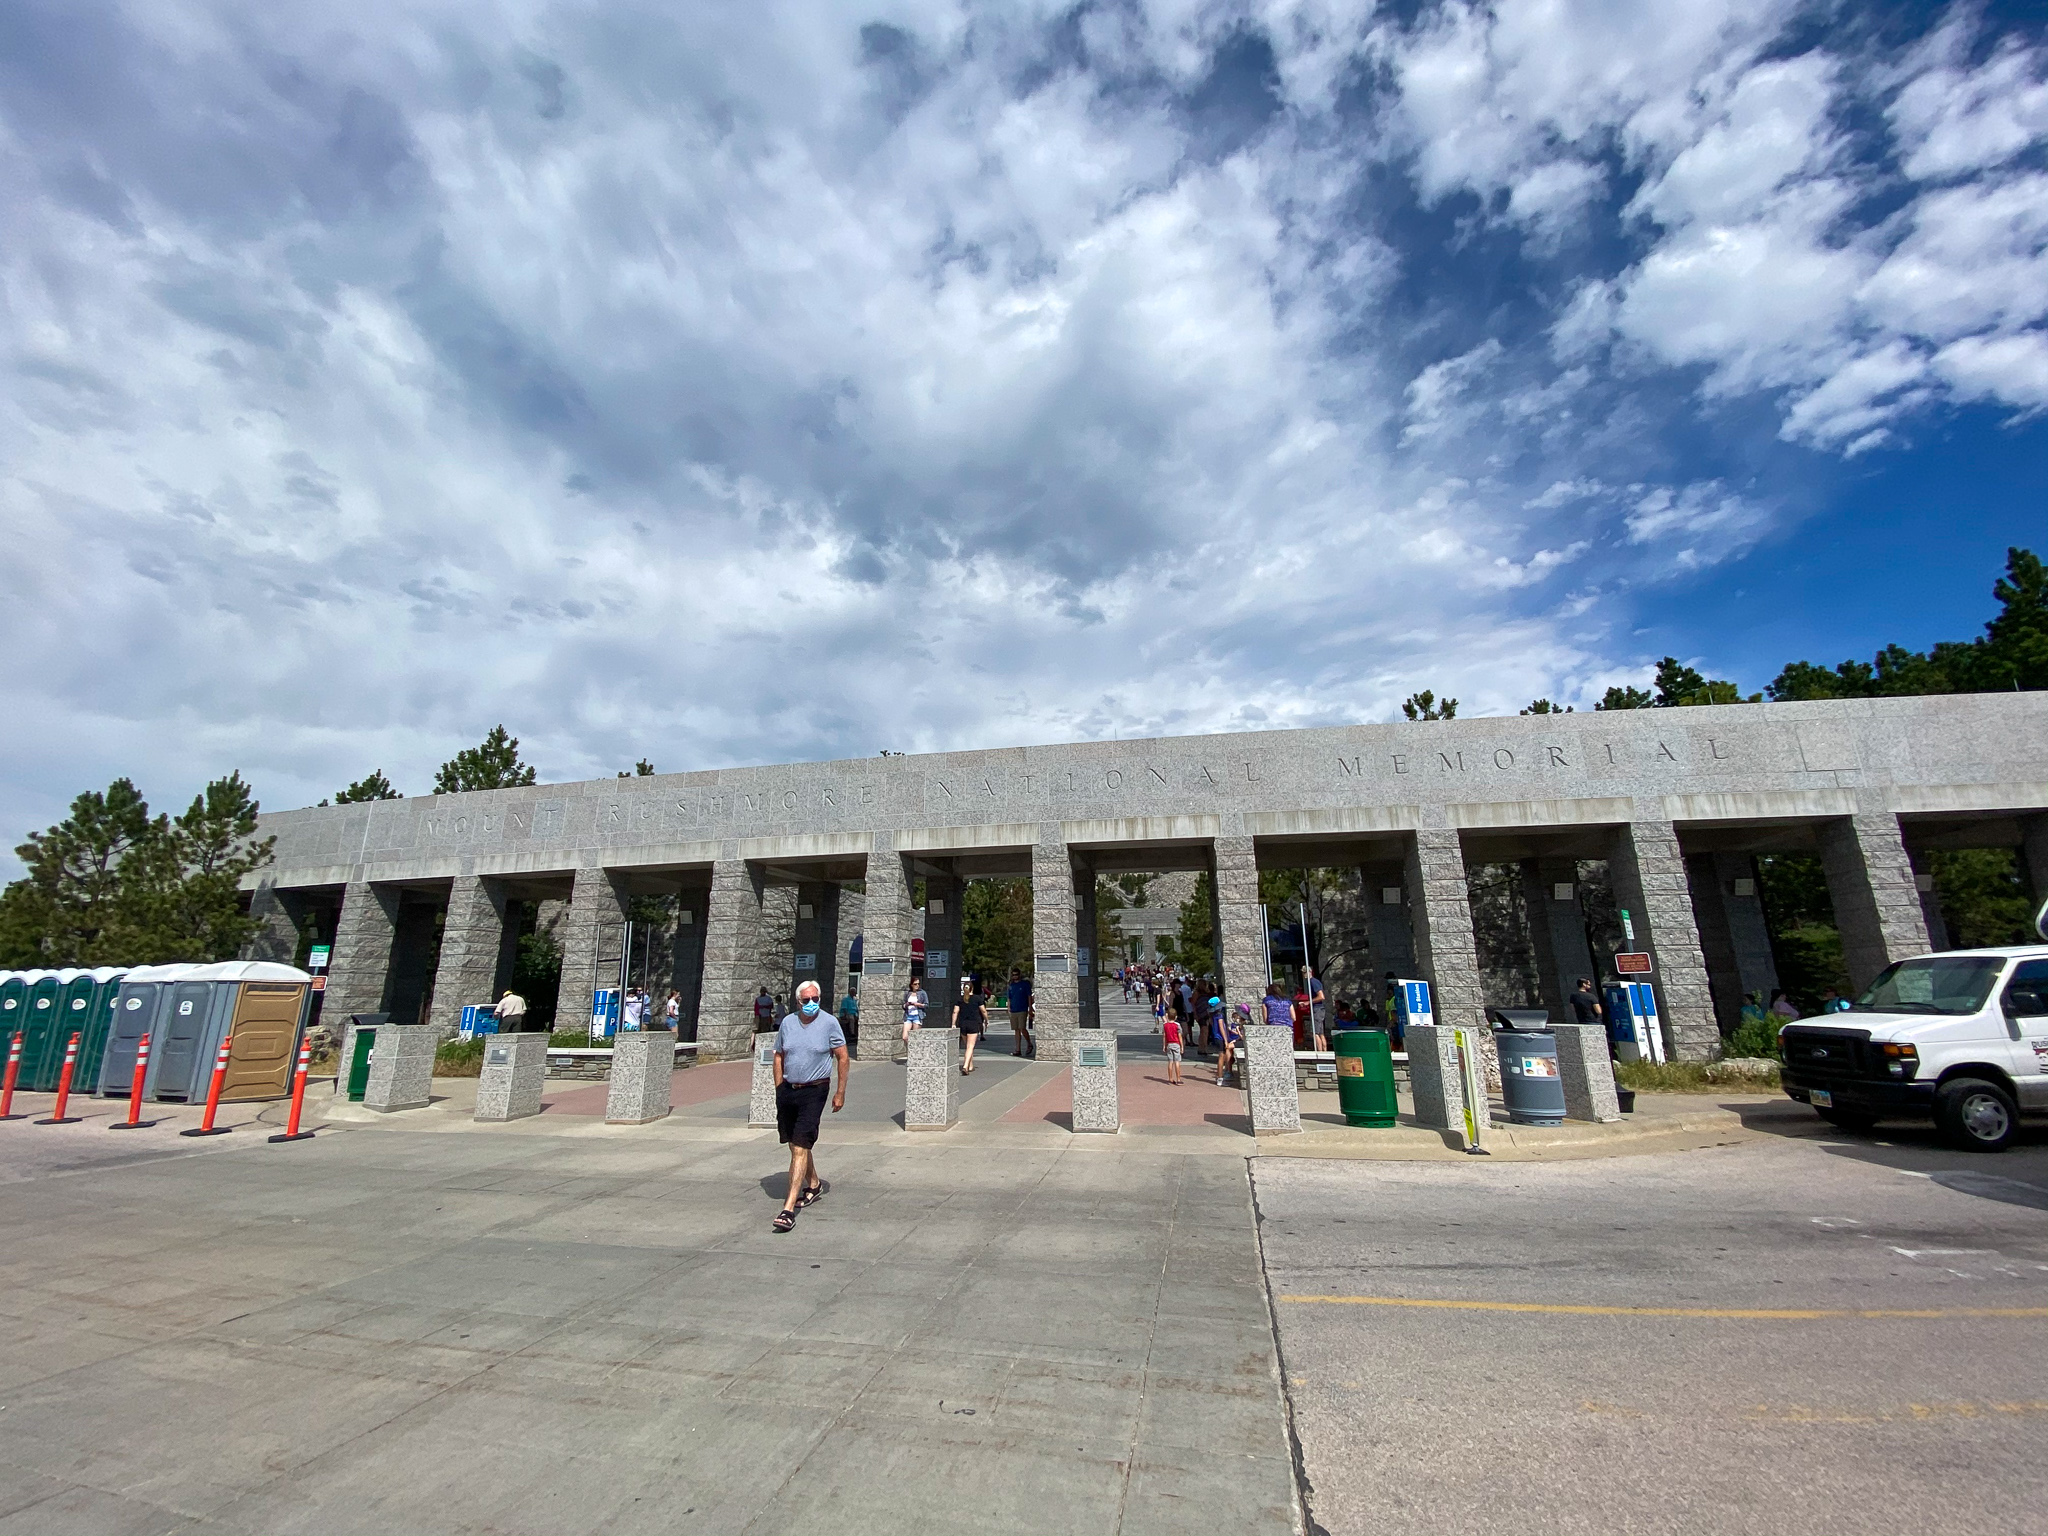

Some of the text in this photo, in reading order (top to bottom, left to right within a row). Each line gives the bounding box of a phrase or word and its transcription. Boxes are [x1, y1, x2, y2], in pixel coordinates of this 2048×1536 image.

[427, 739, 1730, 835] MOUNT RUSHMORE NATIONAL MEMORIAL
